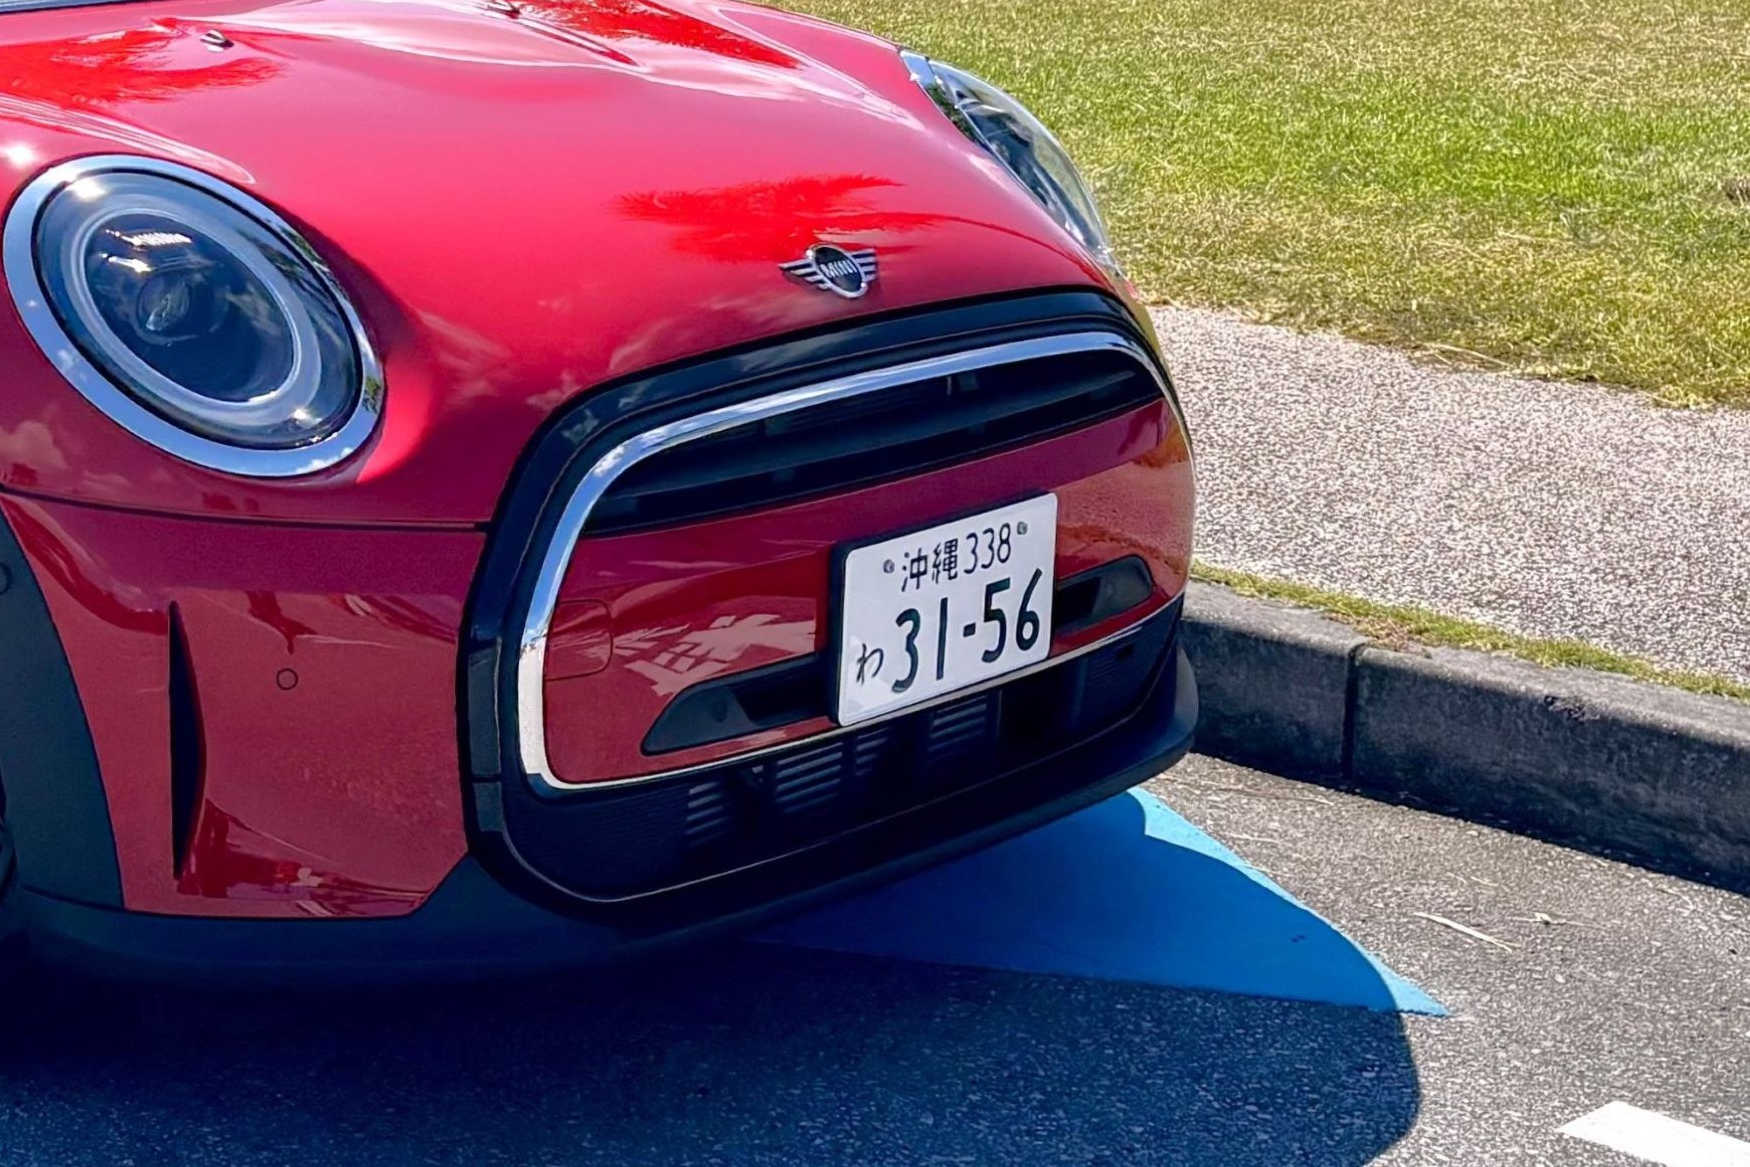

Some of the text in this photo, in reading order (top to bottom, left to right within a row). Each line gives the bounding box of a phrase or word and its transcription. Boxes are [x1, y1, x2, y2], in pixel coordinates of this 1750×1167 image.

[820, 260, 857, 278] MINI
[856, 568, 1042, 693] わ 31-56
